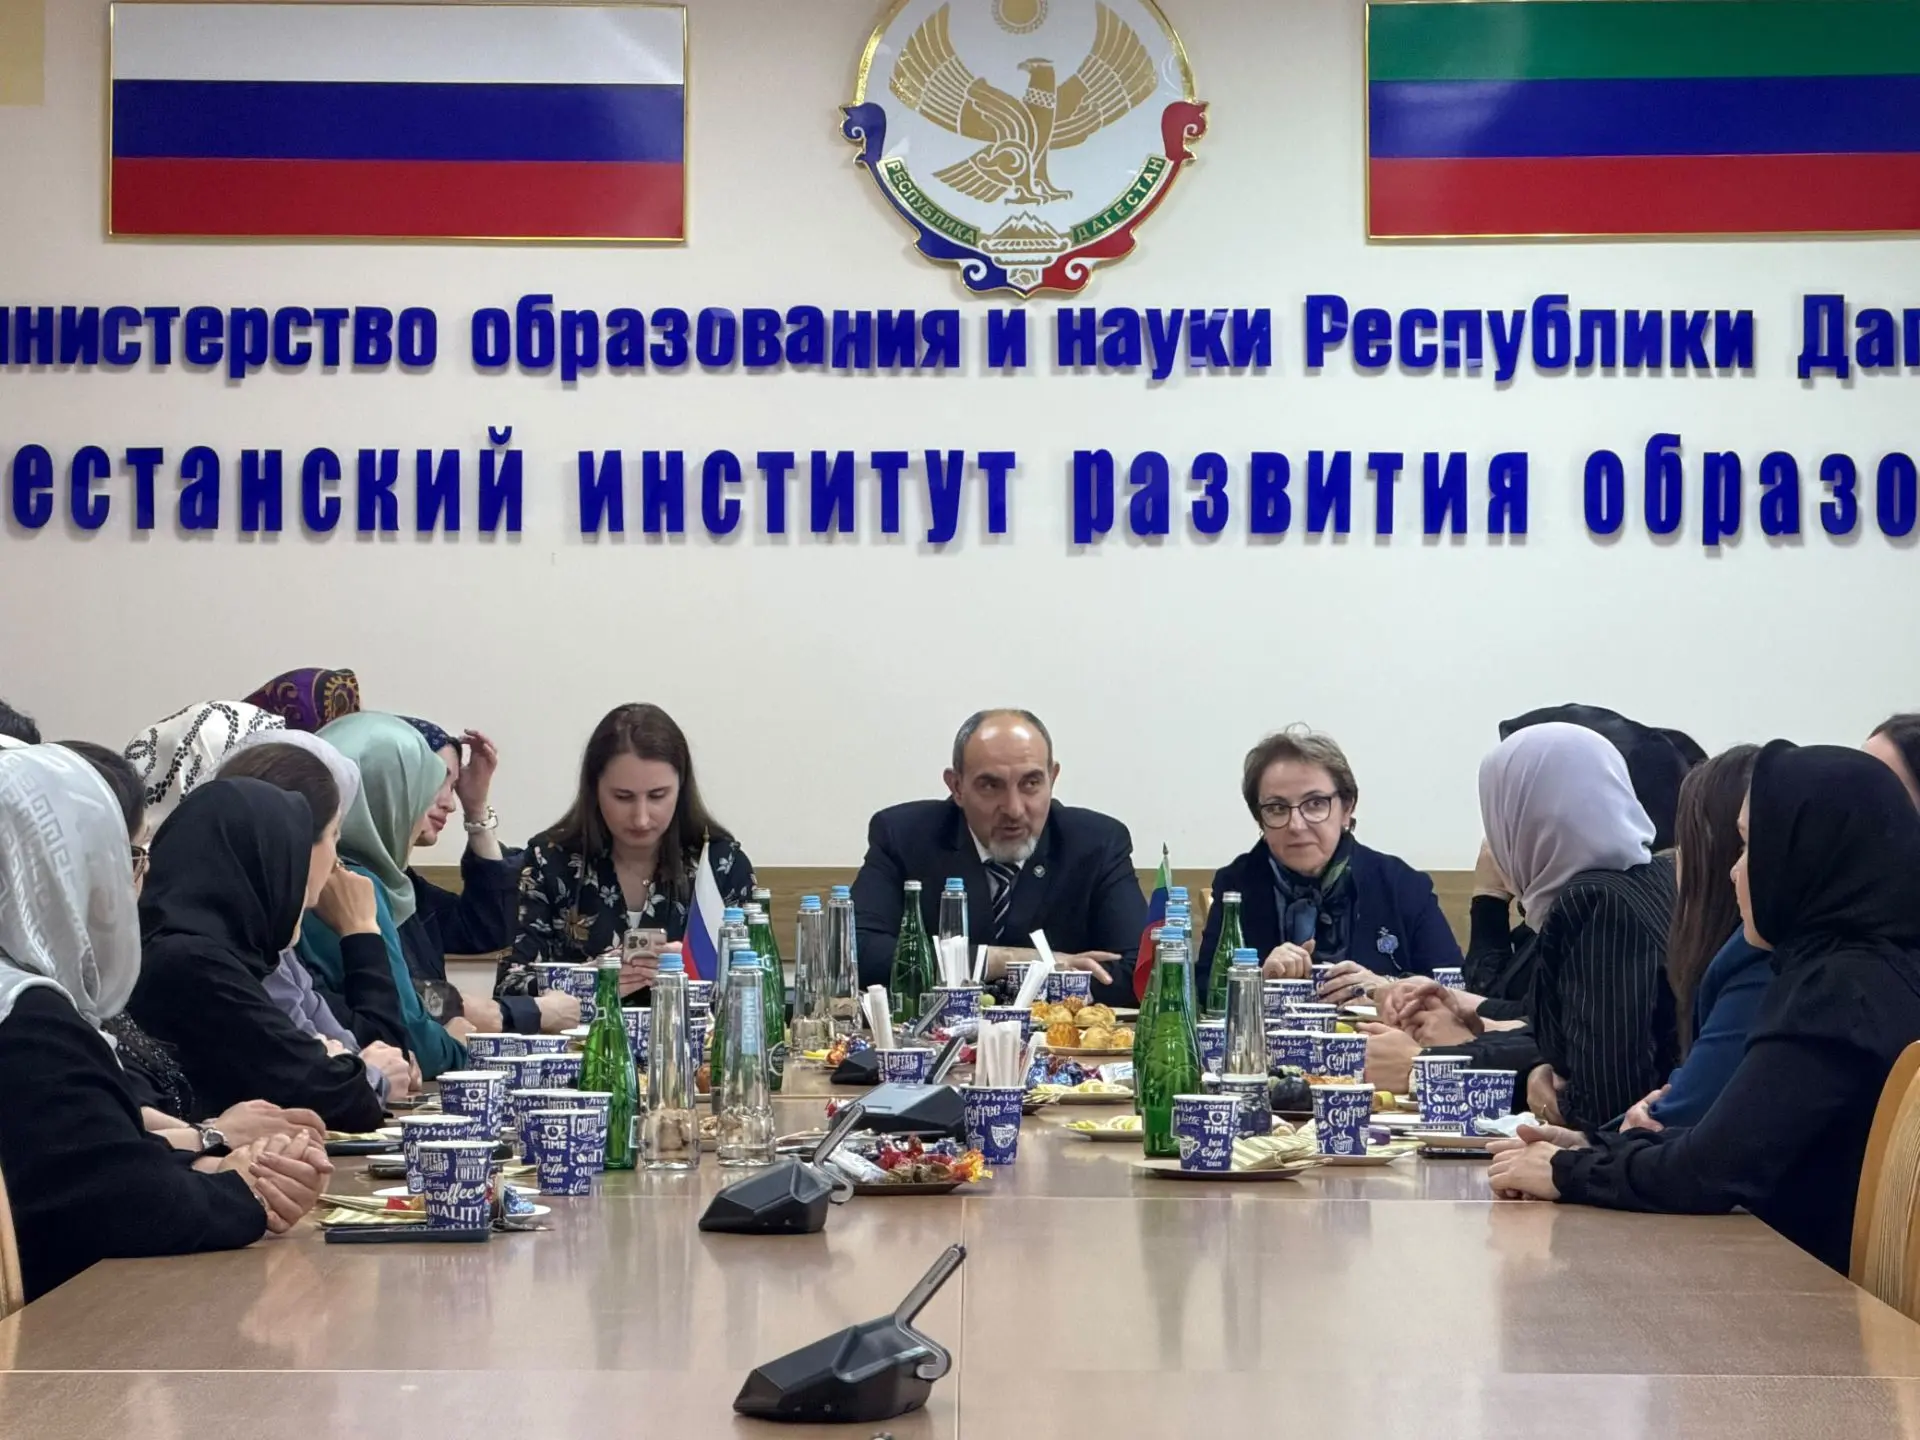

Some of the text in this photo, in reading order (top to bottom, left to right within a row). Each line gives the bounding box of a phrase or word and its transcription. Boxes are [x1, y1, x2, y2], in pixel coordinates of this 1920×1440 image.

[886, 157, 1166, 244] РЕСПУБЛИКА ДАГЕСТАН
[0, 306, 437, 379] нистерство
[471, 294, 960, 382] образования
[988, 309, 1026, 367] и
[1057, 307, 1272, 380] науки
[1305, 294, 1754, 382] Республики
[12, 426, 1918, 546] естанский институт развития образо
[461, 1102, 487, 1111] TIME
[1468, 1087, 1508, 1109] Coffee
[1203, 1125, 1229, 1135] TIME
[541, 1140, 567, 1150] TIME
[433, 1183, 475, 1205] coffee
